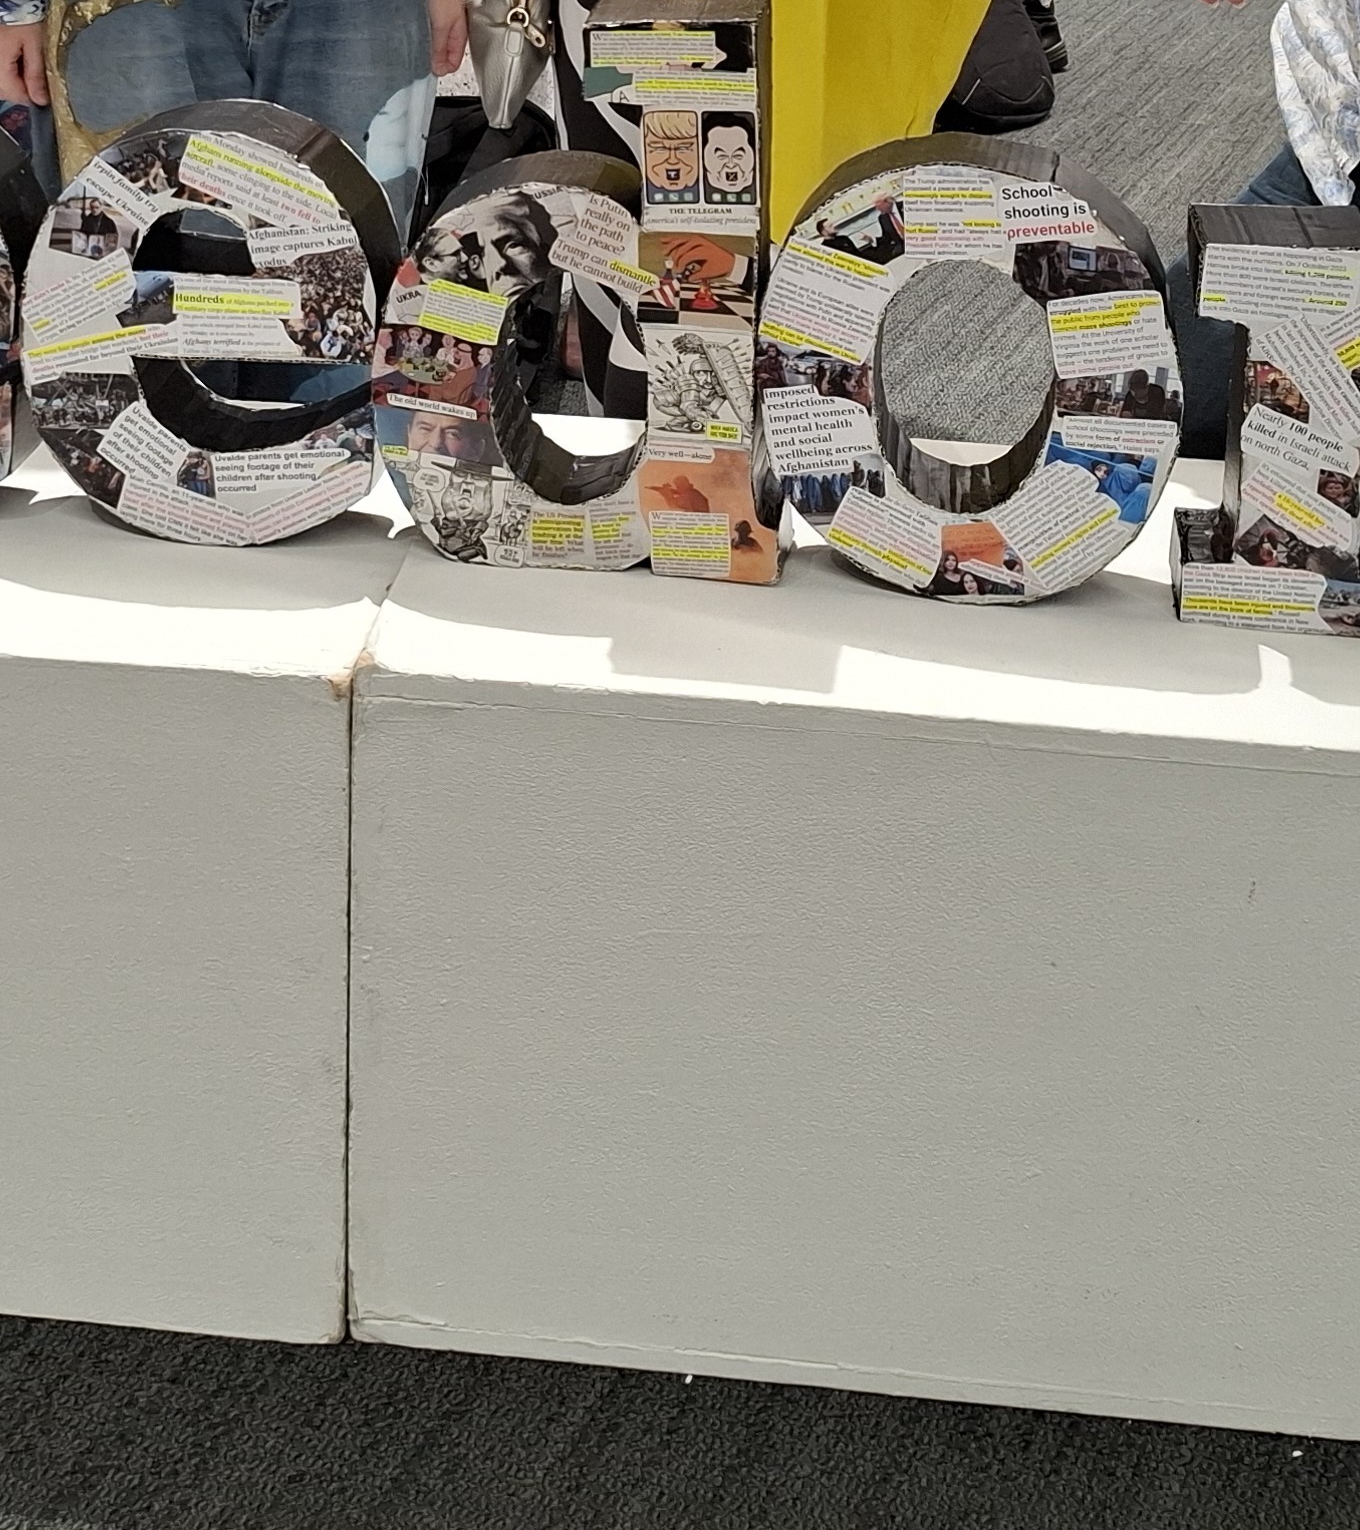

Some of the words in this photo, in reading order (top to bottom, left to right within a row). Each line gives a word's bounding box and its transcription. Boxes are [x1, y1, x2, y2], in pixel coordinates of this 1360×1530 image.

[86, 177, 115, 200] escape
[116, 198, 149, 226] Ukraine
[114, 178, 144, 202] family
[145, 199, 159, 213] try
[1002, 185, 1052, 200] School
[589, 195, 598, 205] Is
[600, 198, 628, 218] Putin
[1005, 205, 1069, 219] shooting
[1074, 202, 1086, 214] is
[585, 208, 616, 226] really
[616, 221, 630, 232] on
[248, 227, 309, 242] Afghanistan:
[312, 223, 352, 235] Striking
[580, 218, 596, 232] the
[598, 227, 624, 242] path
[1007, 222, 1095, 240] preventable
[251, 244, 280, 255] image
[283, 240, 325, 252] captures
[327, 235, 357, 247] Kabul
[575, 231, 587, 242] to
[588, 238, 625, 256] peace?
[552, 250, 568, 262] but
[570, 257, 582, 269] he
[583, 264, 615, 282] cannot
[618, 275, 643, 293] build
[557, 239, 590, 259] Trump
[591, 255, 608, 267] can
[610, 261, 656, 286] dismantle
[175, 294, 224, 305] Hundreds
[765, 384, 815, 399] imposed
[767, 398, 836, 411] restrictions
[769, 412, 810, 423] impact
[813, 406, 865, 418] women's
[771, 423, 813, 436] mental
[815, 419, 853, 430] health
[1254, 407, 1288, 428] Nearly
[1289, 422, 1308, 436] 100
[1308, 432, 1343, 452] people
[773, 437, 795, 448] and
[799, 433, 832, 445] social
[1241, 434, 1253, 443] on
[1255, 440, 1280, 456] north
[1248, 420, 1278, 438] killed
[1278, 432, 1288, 443] in
[1290, 438, 1320, 458] Israeli
[1321, 452, 1351, 472] attack
[248, 453, 282, 463] parents
[284, 452, 299, 460] get
[300, 450, 345, 458] emotional
[775, 447, 833, 460] wellbeing
[835, 444, 872, 454] across
[247, 463, 280, 472] footage
[778, 459, 849, 473] Afghanistan
[217, 484, 257, 492] occurred
